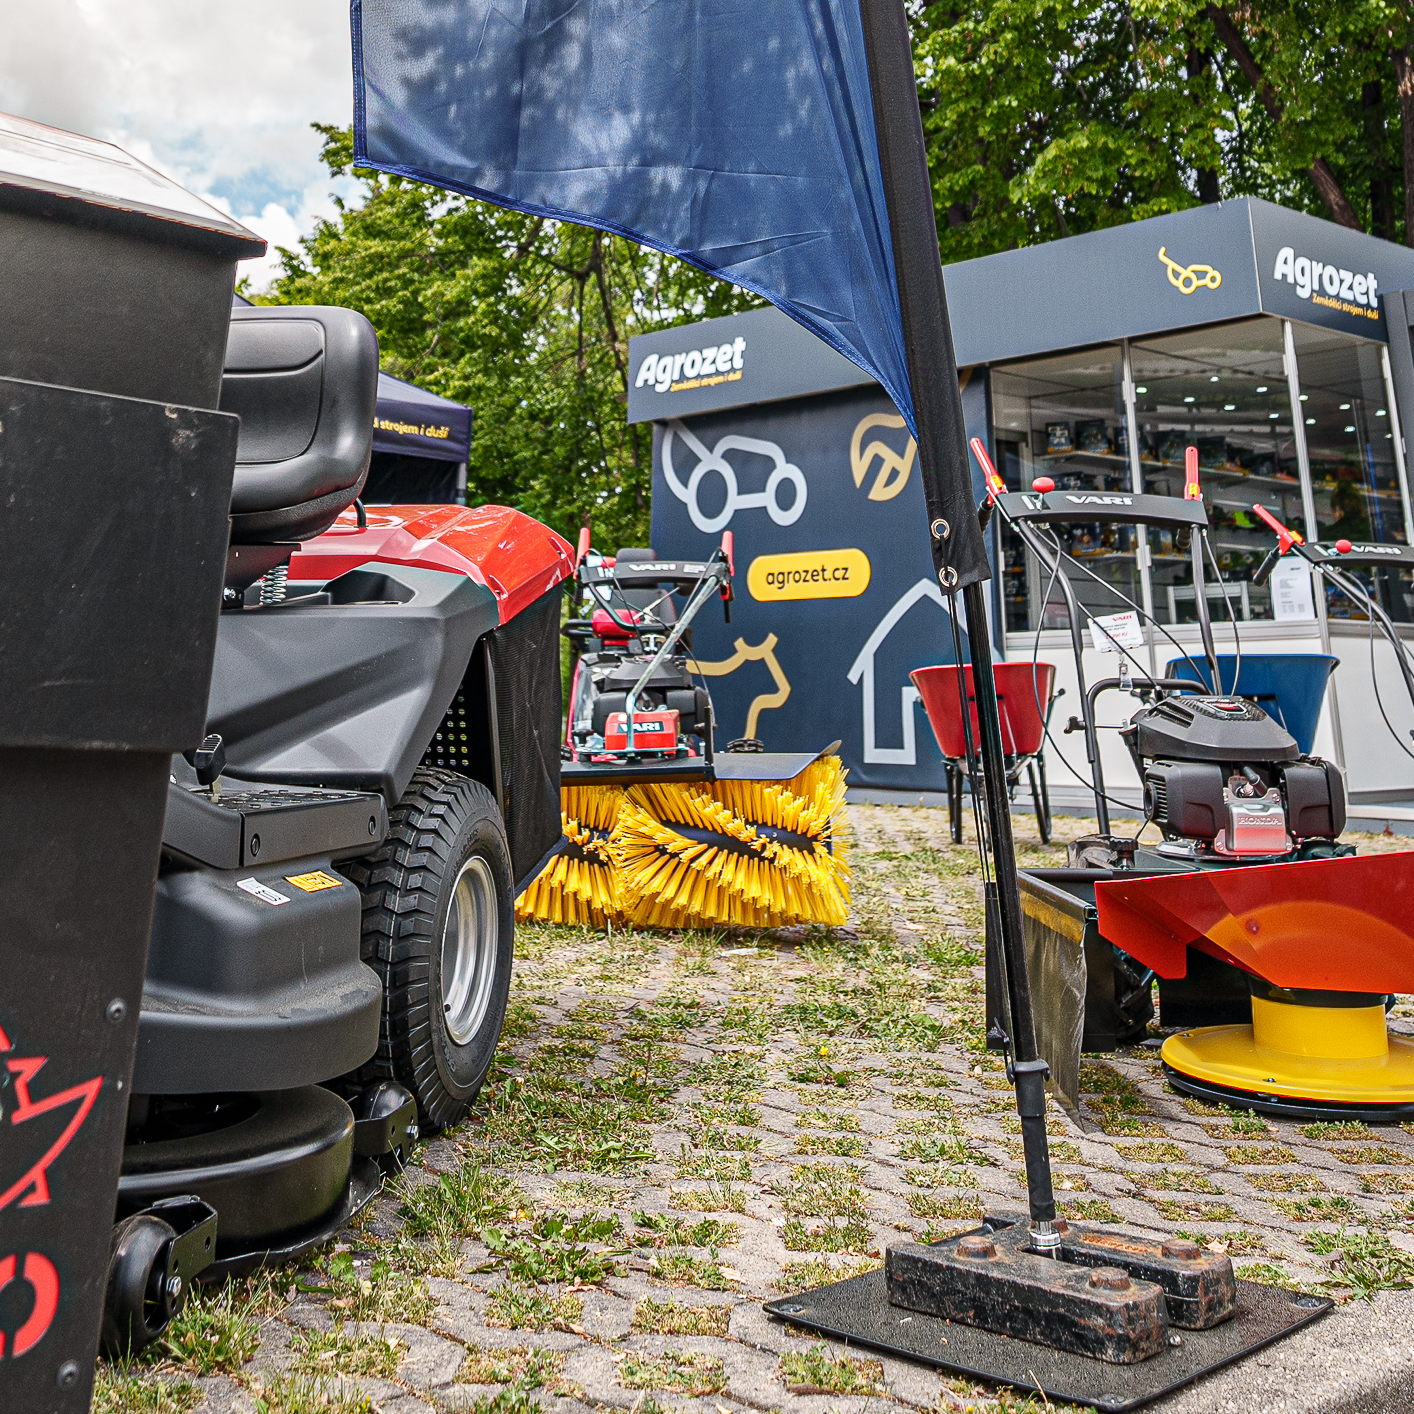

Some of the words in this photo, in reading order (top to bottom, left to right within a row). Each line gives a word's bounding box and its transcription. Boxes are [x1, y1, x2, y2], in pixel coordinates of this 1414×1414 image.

[1273, 246, 1378, 309] Agrozet
[634, 336, 746, 393] Agrozet
[379, 418, 419, 436] strojem
[420, 424, 426, 436] i
[425, 425, 450, 439] duší
[1066, 495, 1132, 505] VARI
[628, 564, 677, 572] VARI
[766, 564, 850, 590] agrozet.cz
[1237, 816, 1283, 826] HONDA
